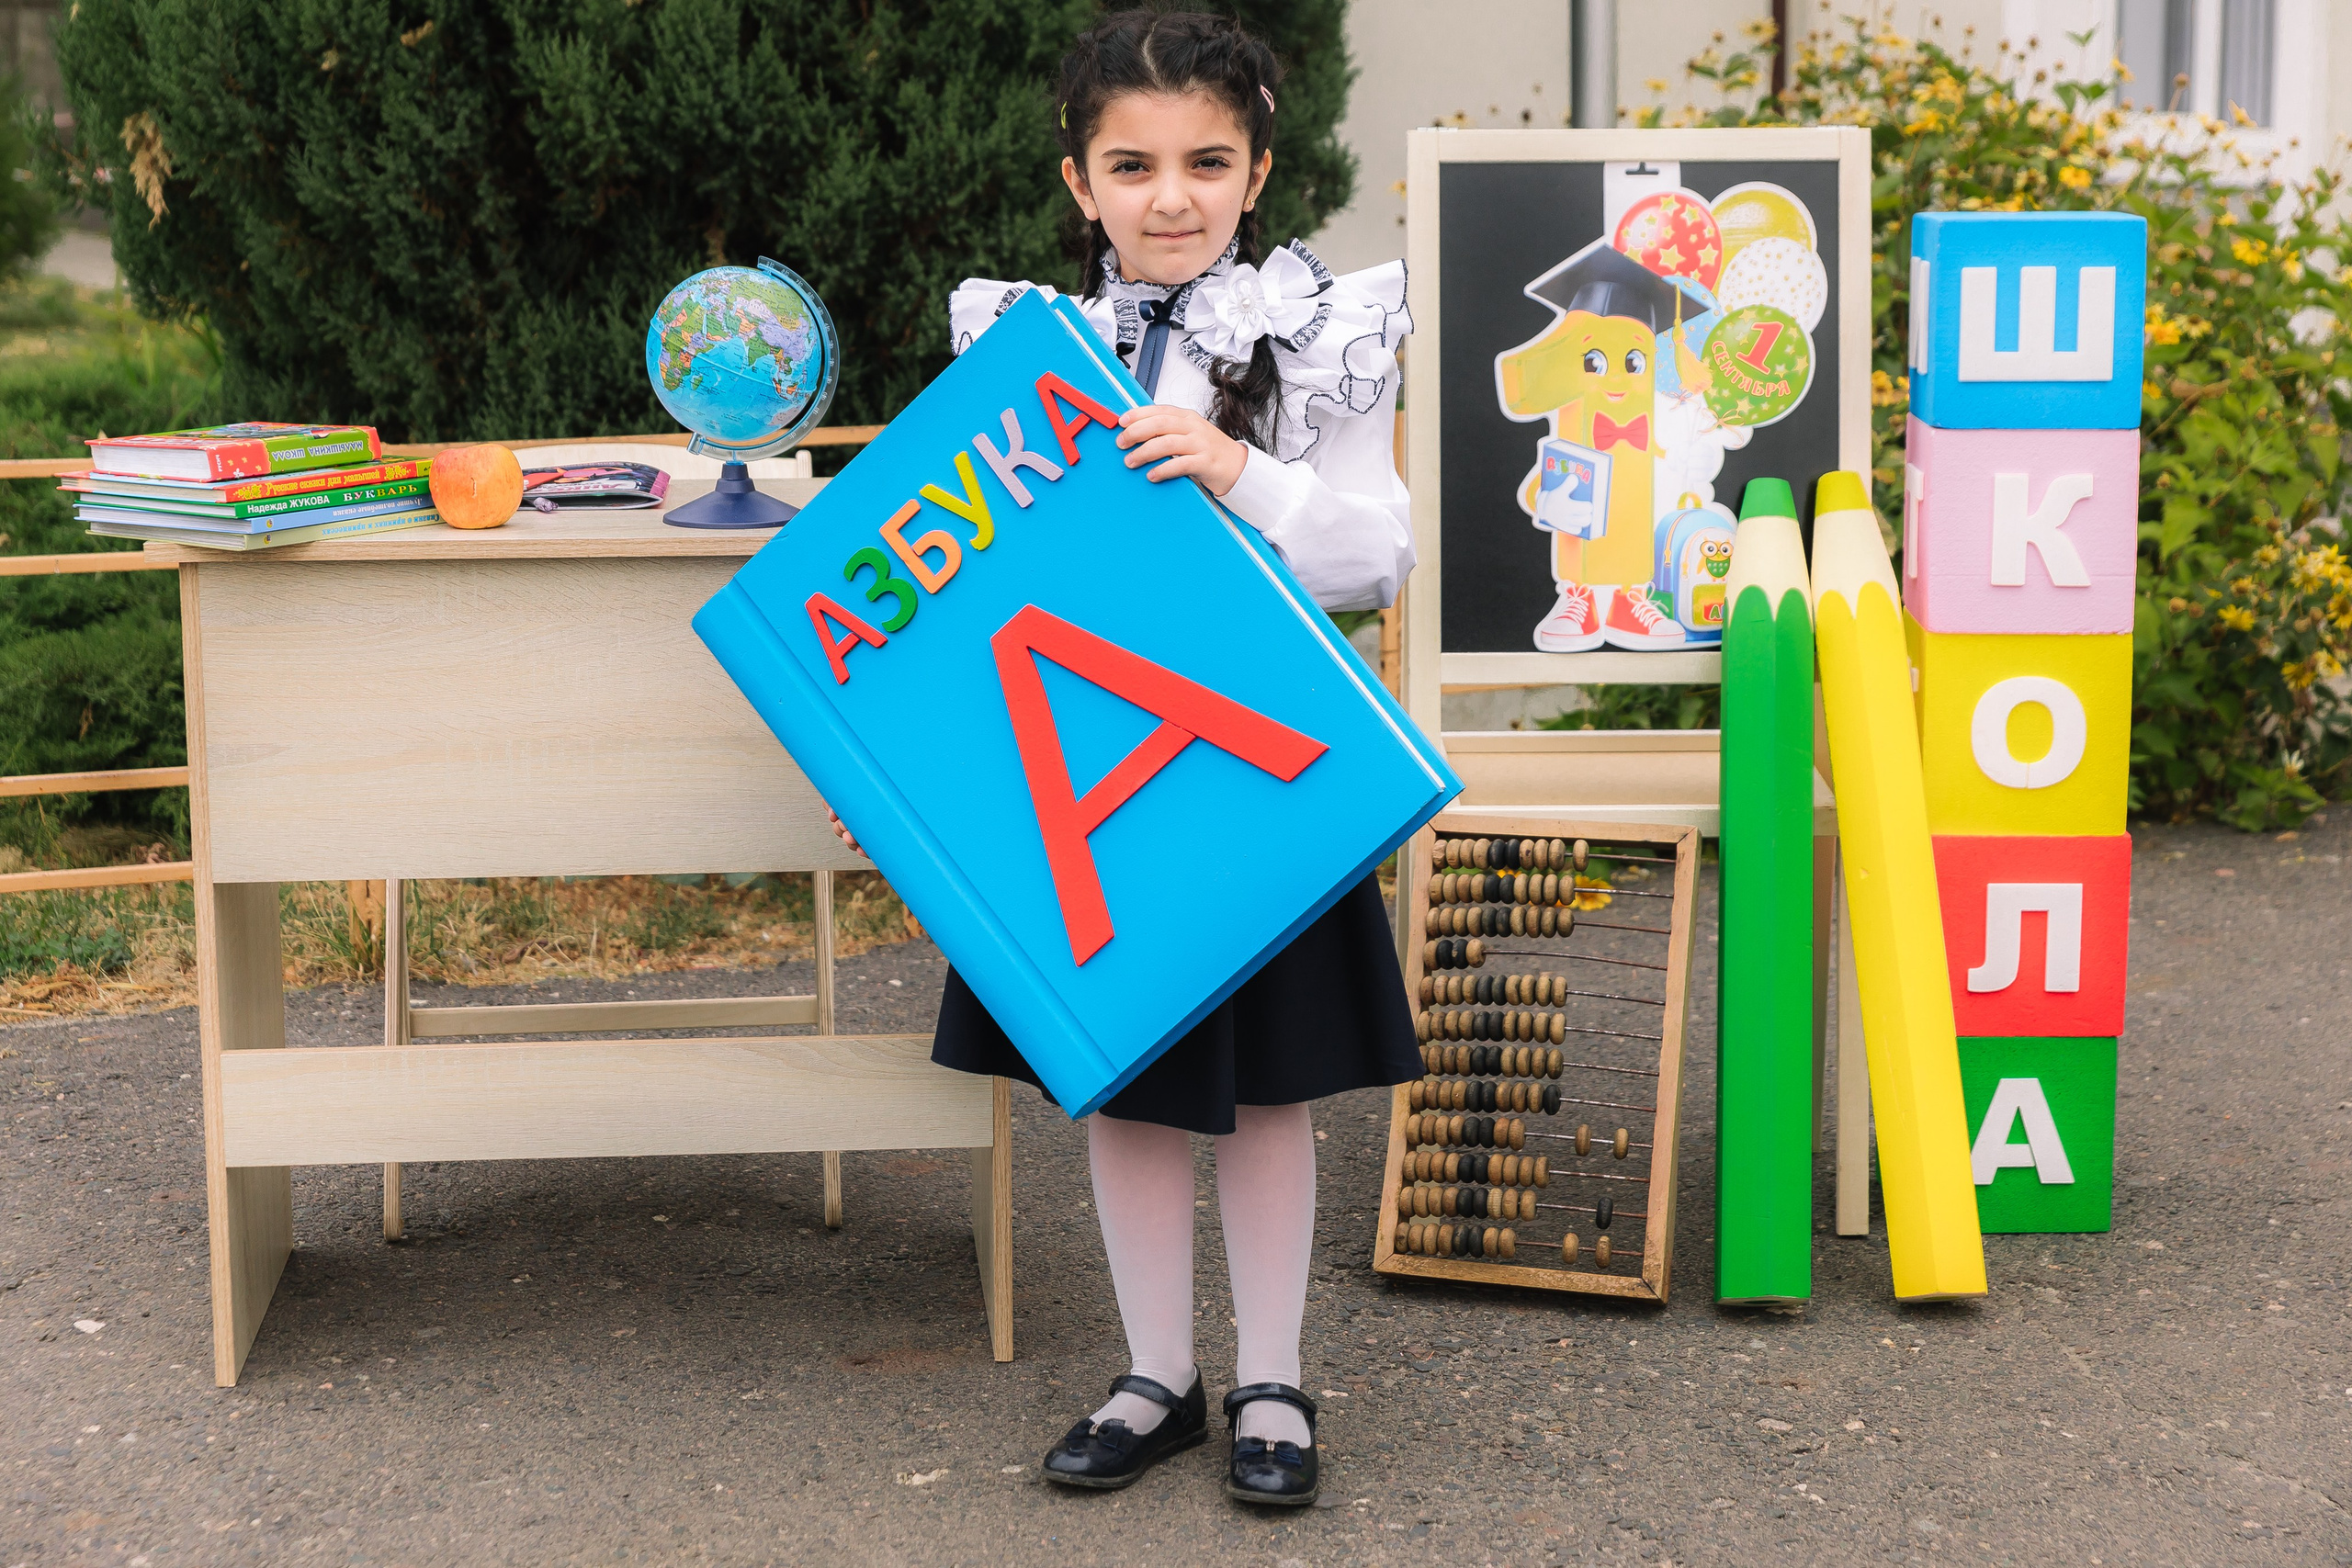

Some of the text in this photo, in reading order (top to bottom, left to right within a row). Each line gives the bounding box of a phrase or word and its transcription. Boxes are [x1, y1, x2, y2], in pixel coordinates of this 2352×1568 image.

[1736, 321, 1784, 375] 1
[1711, 341, 1791, 397] СЕНТЯБРЯ
[272, 441, 364, 461] МАЛЫШКИНА ШКОЛА
[266, 469, 380, 496] Русские сказки для малышей
[343, 484, 419, 502] БУКВАРЬ
[247, 494, 331, 514] Надежда ЖУКОВА
[333, 508, 356, 517] сказки
[357, 502, 395, 513] волшебные
[374, 517, 406, 529] принцах
[413, 513, 440, 523] Сказки
[804, 370, 1122, 685] АЗБУКА
[322, 523, 366, 536] принцессах
[1959, 265, 2116, 1185] ШКОЛА
[989, 603, 1331, 967] А
